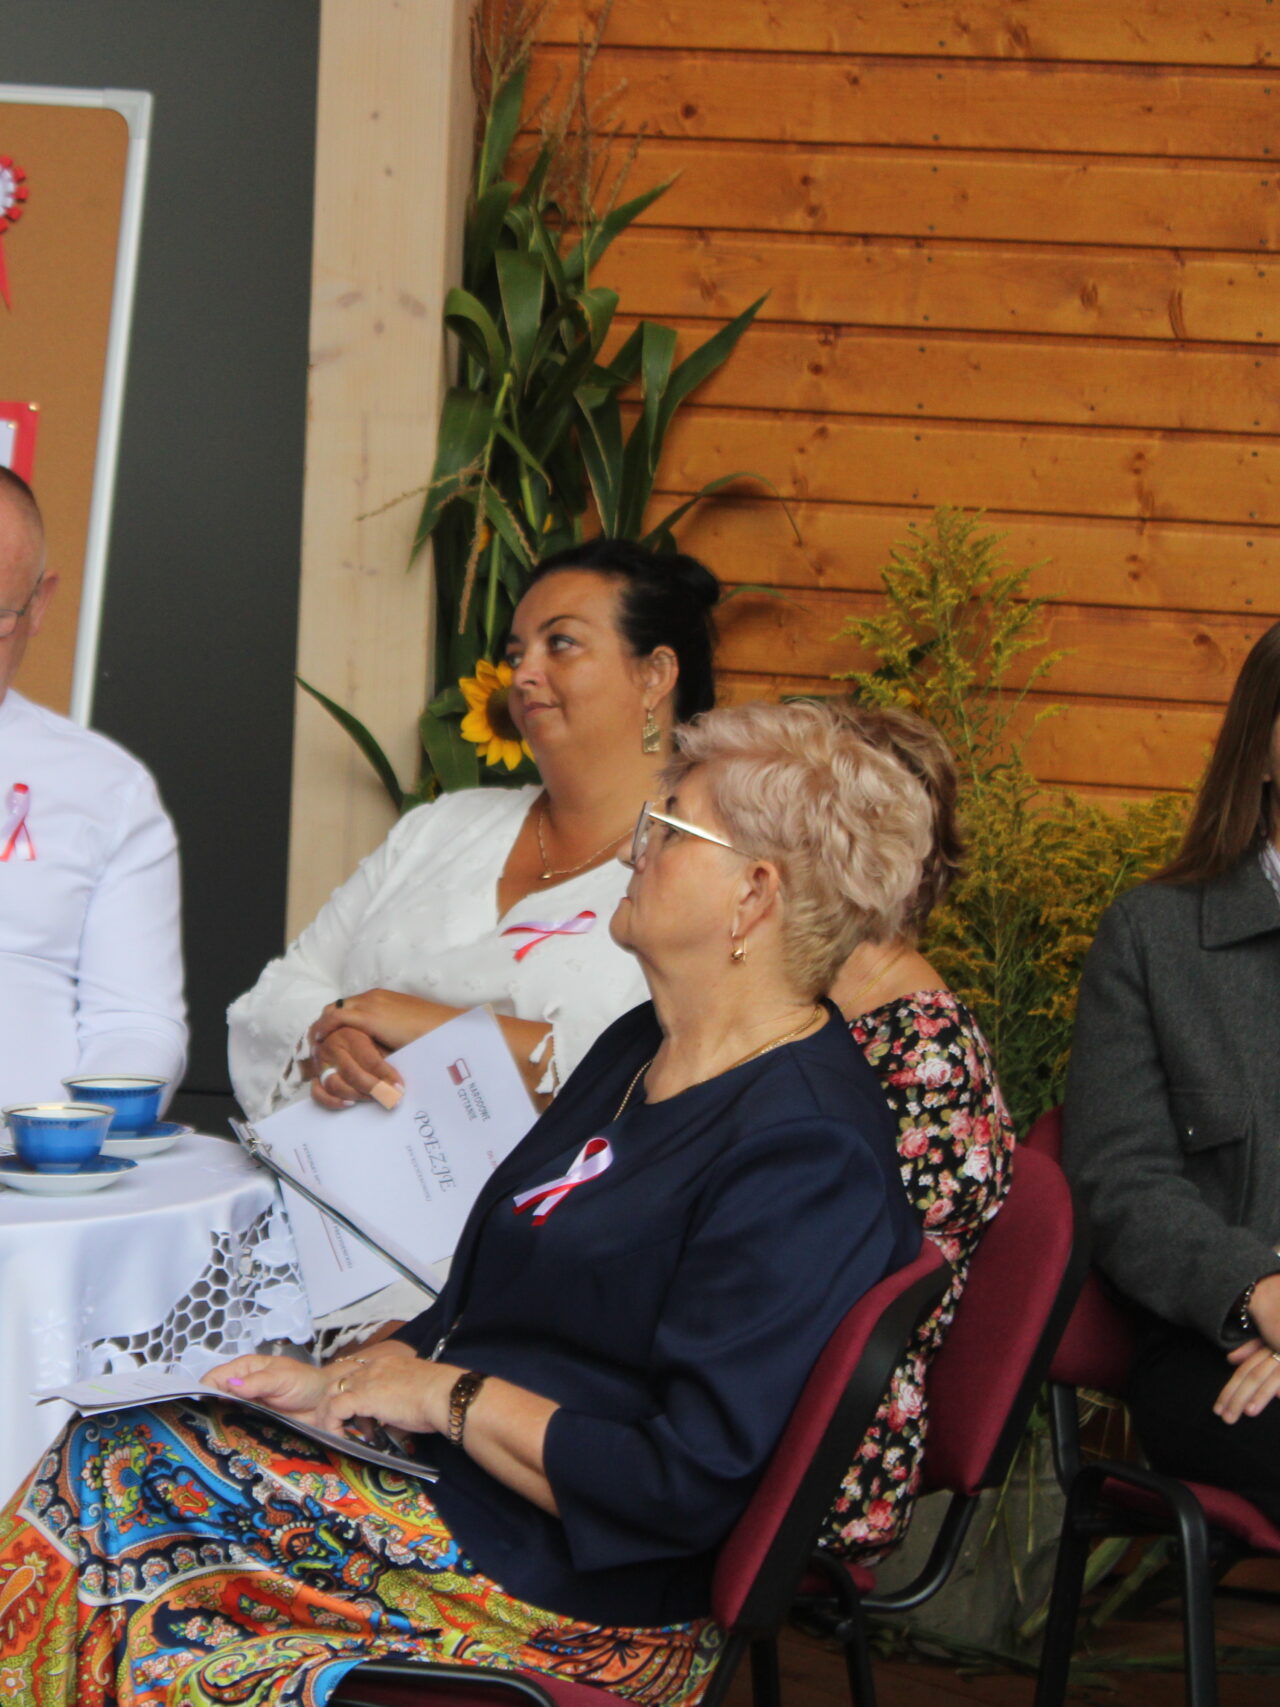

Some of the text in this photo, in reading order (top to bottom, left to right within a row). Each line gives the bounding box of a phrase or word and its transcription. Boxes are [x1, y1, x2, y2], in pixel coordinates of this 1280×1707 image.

[457, 1088, 477, 1121] CZYTANIE
[468, 1081, 491, 1122] NARODOWE
[414, 1110, 456, 1193] POEZJE
